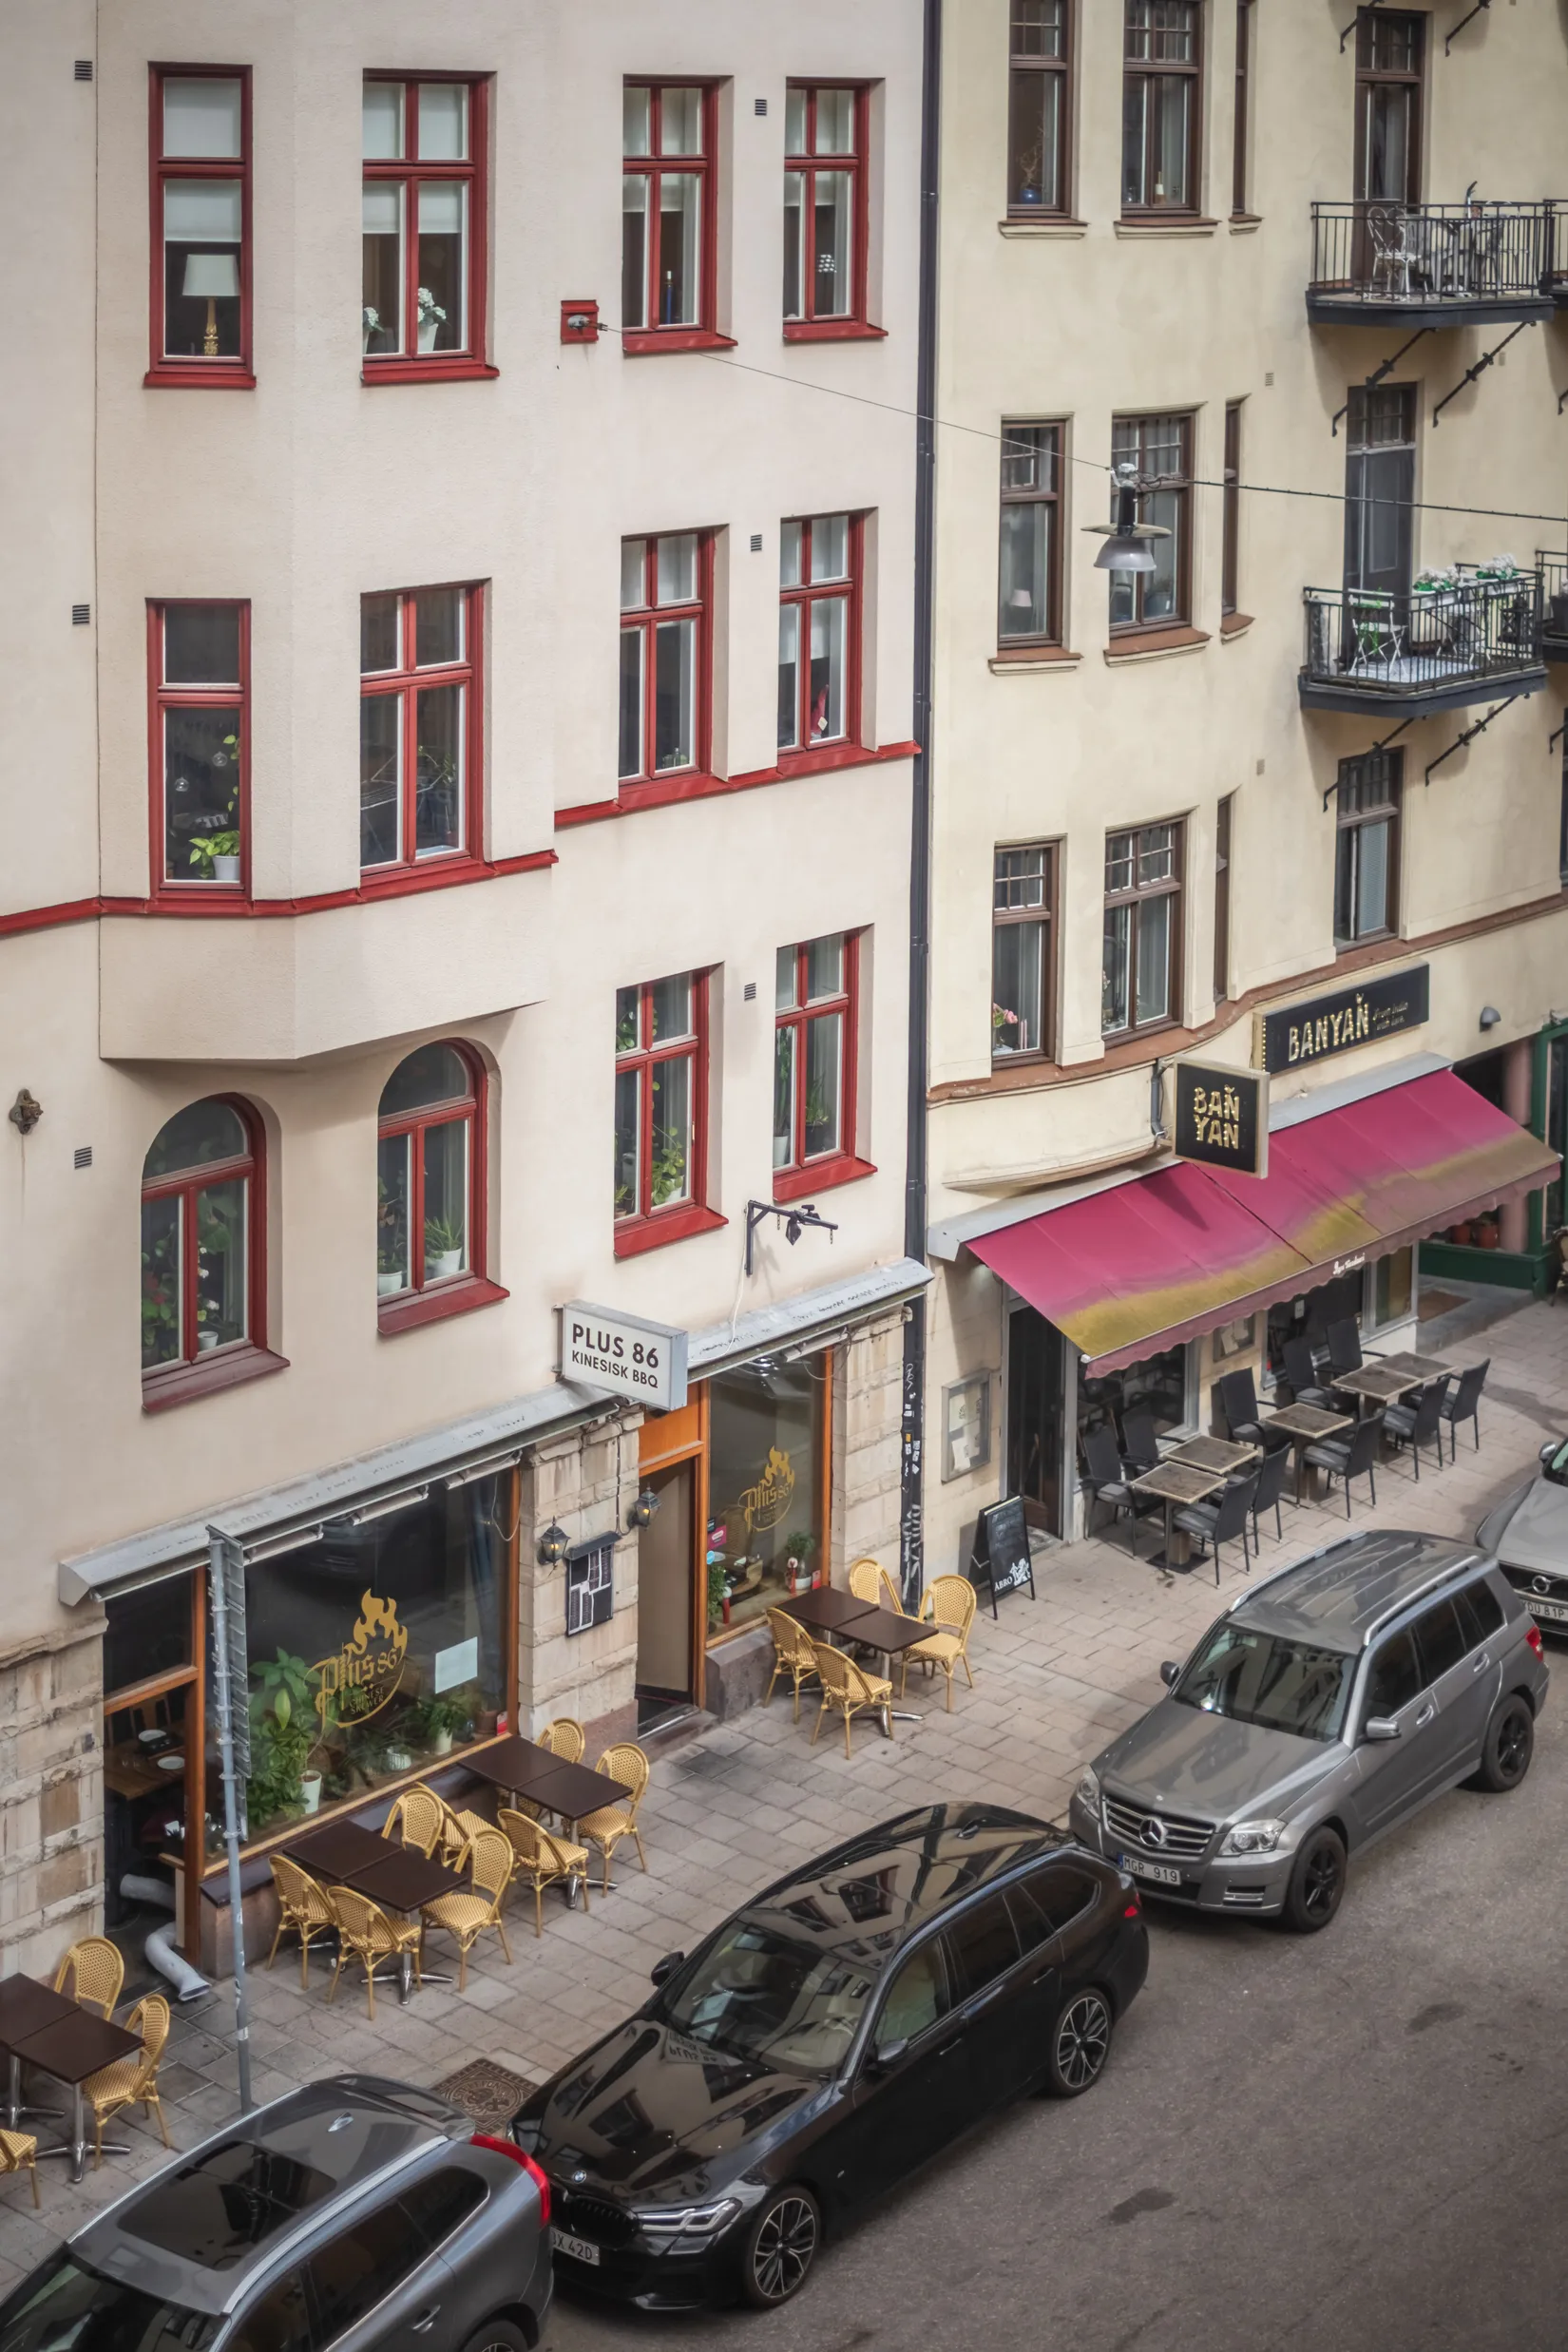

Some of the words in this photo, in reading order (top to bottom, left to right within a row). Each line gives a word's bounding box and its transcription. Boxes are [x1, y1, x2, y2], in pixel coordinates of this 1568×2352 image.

[1194, 1114, 1239, 1150] YAN
[572, 1323, 624, 1358] PLUS
[632, 1342, 660, 1369] 86
[572, 1349, 629, 1380] KINESISK
[632, 1369, 659, 1389] BBQ
[1124, 1857, 1145, 1875] MGR
[1154, 1866, 1177, 1883] 919
